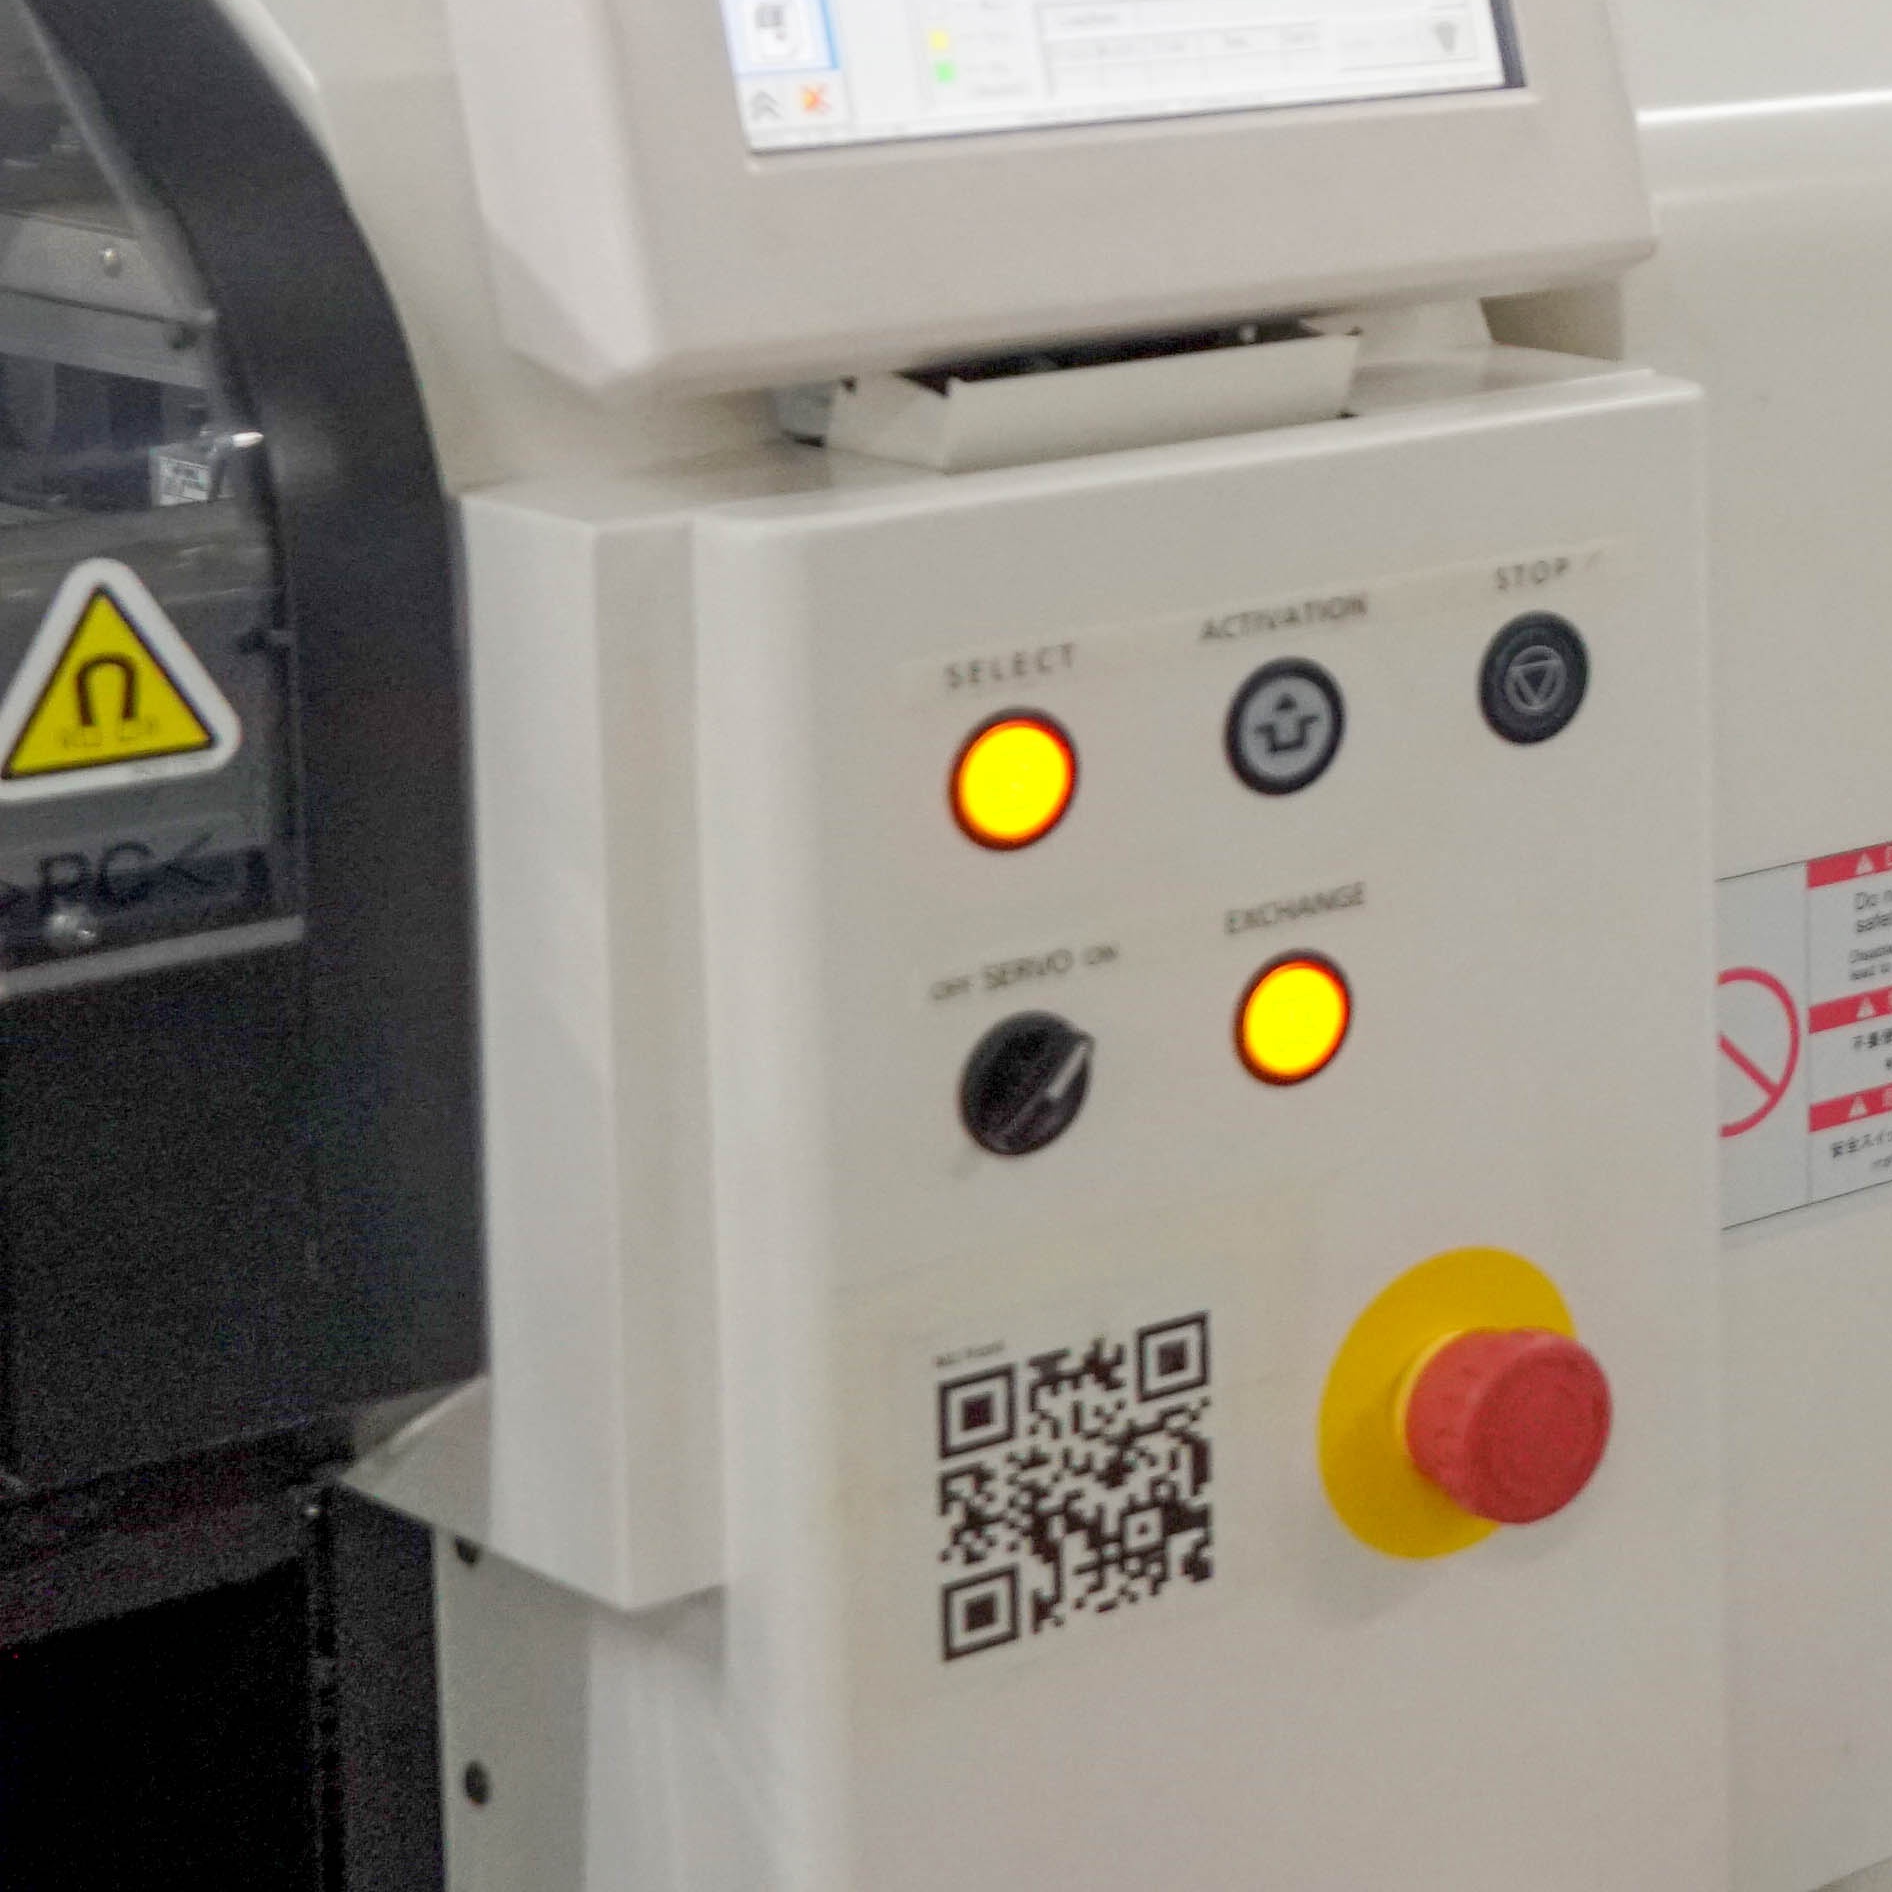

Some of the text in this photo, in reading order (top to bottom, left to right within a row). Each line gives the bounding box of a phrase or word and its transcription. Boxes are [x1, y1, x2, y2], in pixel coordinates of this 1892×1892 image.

[1496, 557, 1570, 591] STOP
[1201, 592, 1367, 640] ACTIVATION
[945, 641, 1077, 688] SELECT
[1224, 882, 1367, 935] EXCHANGE
[1854, 891, 1880, 911] Do
